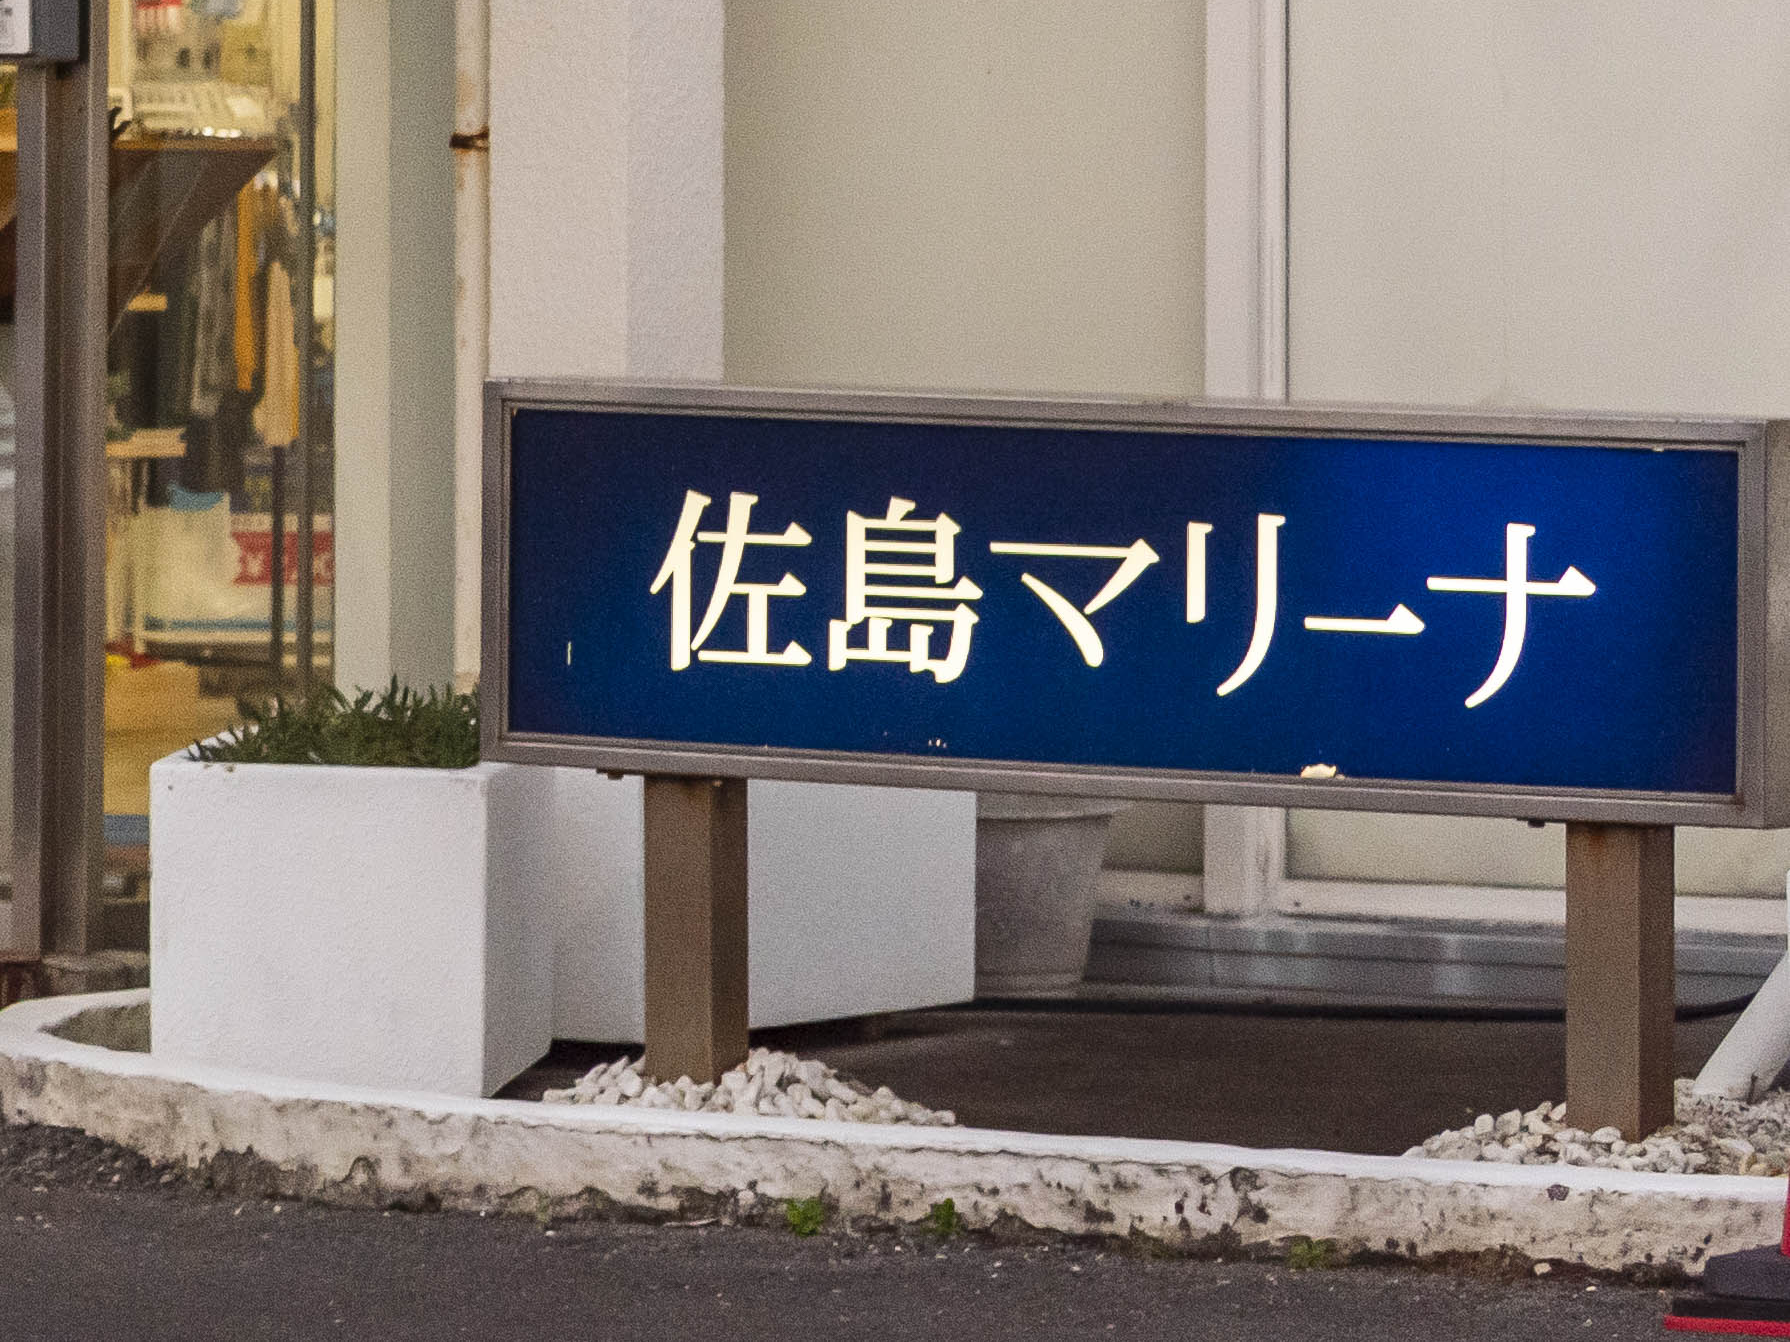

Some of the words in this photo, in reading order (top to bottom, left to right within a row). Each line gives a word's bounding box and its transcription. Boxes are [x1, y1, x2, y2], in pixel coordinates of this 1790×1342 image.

[648, 489, 1597, 710] 佐島マリーナ
